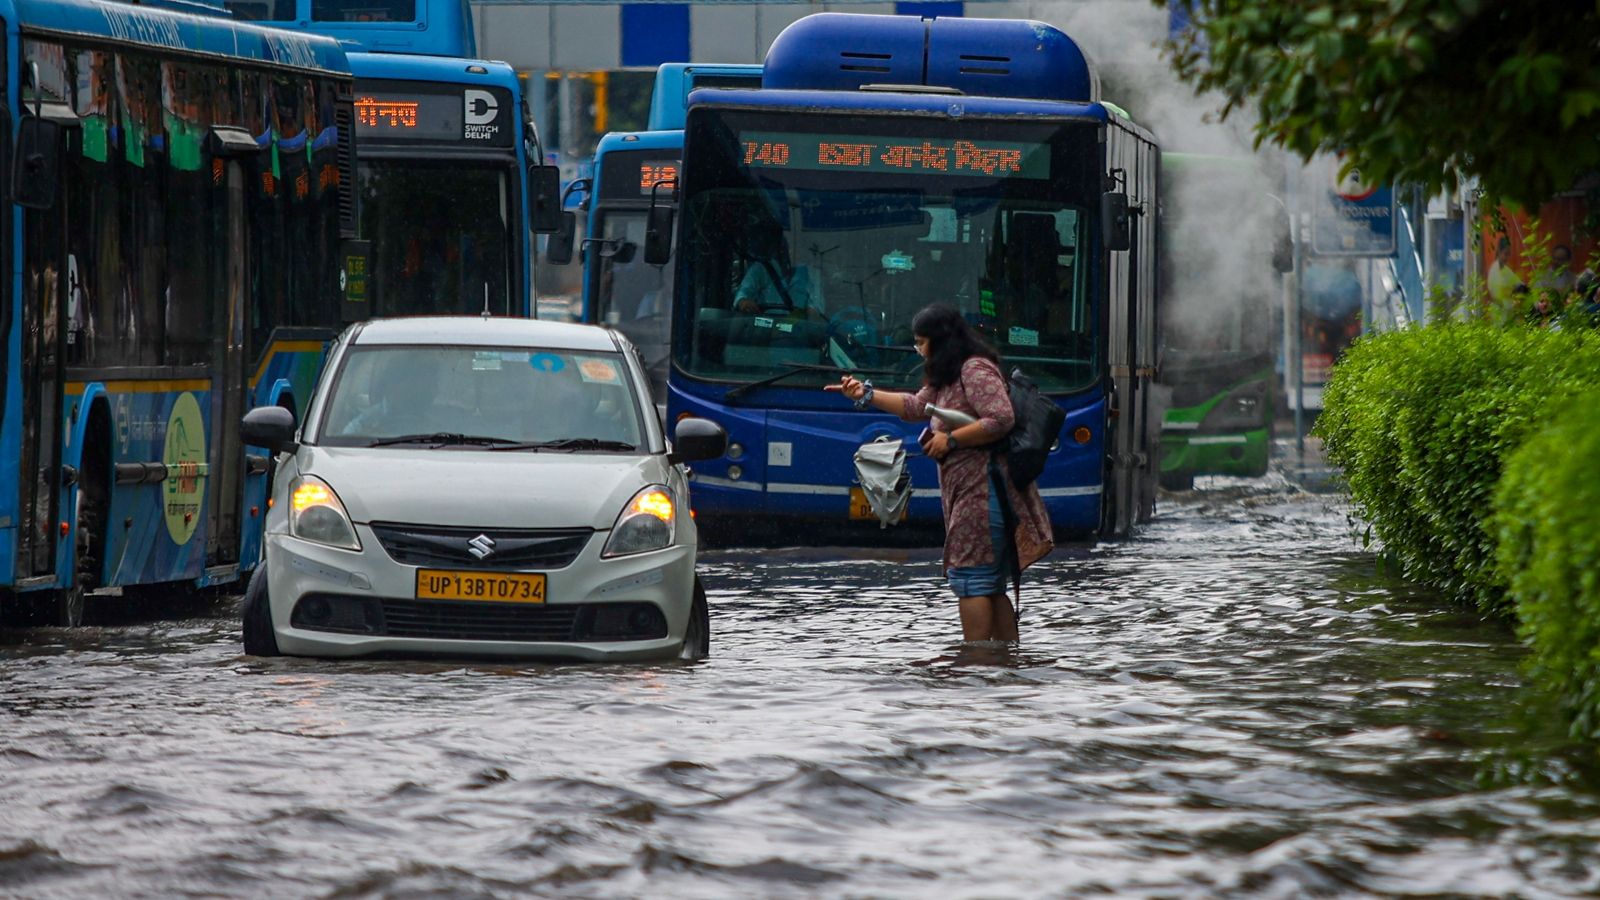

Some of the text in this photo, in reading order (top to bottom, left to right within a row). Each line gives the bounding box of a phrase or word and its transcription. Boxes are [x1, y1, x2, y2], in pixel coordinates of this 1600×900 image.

[465, 125, 499, 133] SWITCH
[742, 142, 789, 165] 740
[952, 141, 1021, 175] विहार
[430, 576, 542, 599] UP13BT0734
